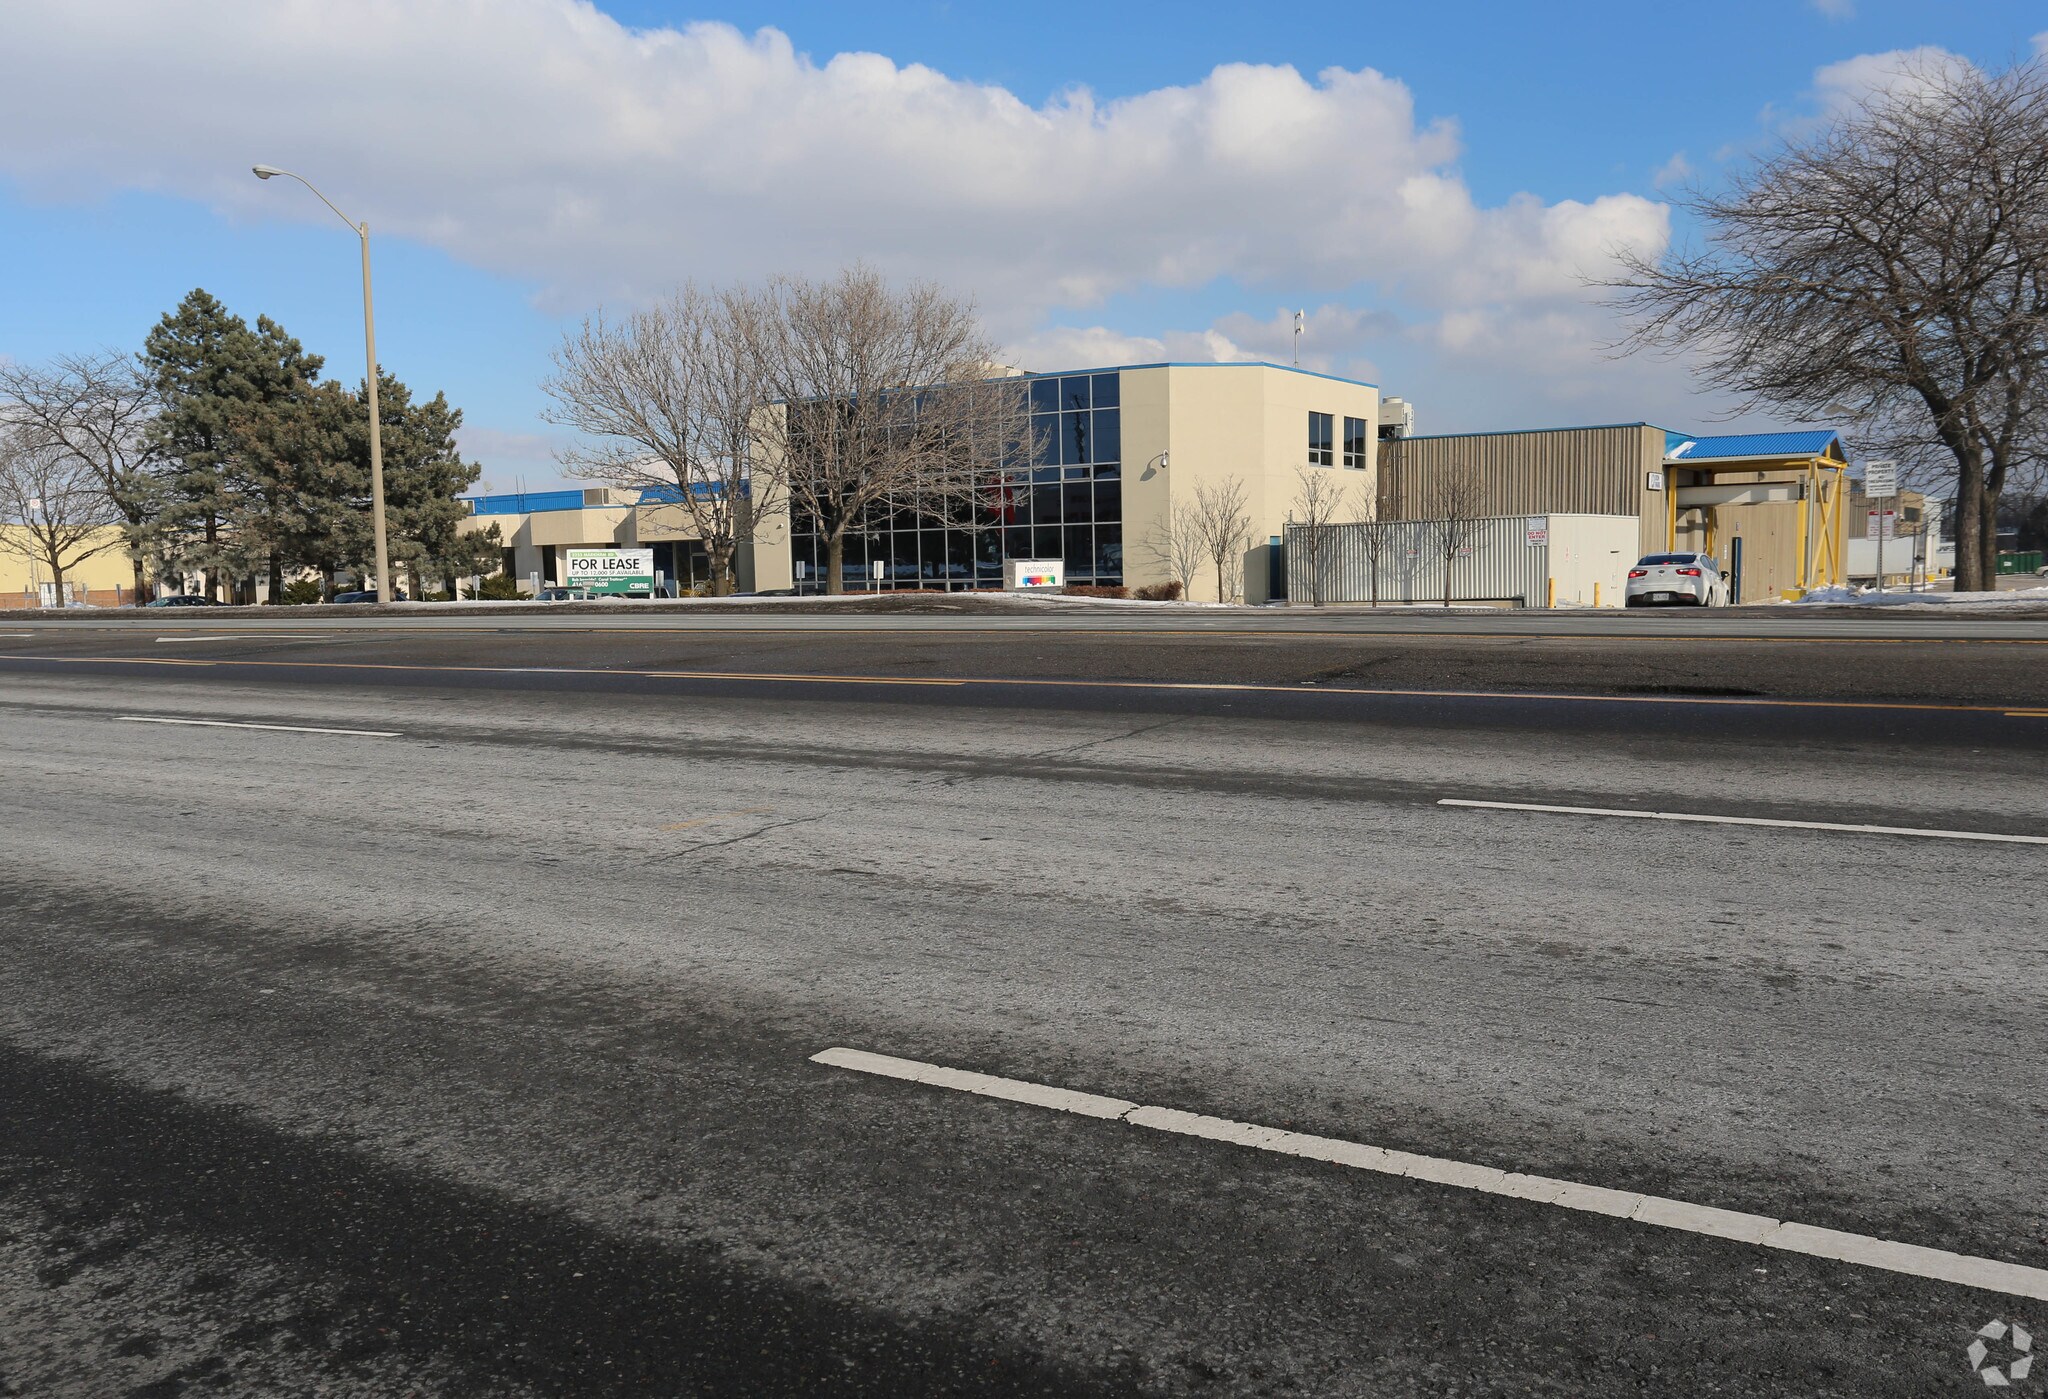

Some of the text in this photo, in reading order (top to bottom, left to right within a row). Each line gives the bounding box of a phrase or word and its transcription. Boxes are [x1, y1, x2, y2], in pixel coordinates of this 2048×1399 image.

[572, 558, 640, 570] FOR LEASE
[1024, 564, 1054, 573] technicolor
